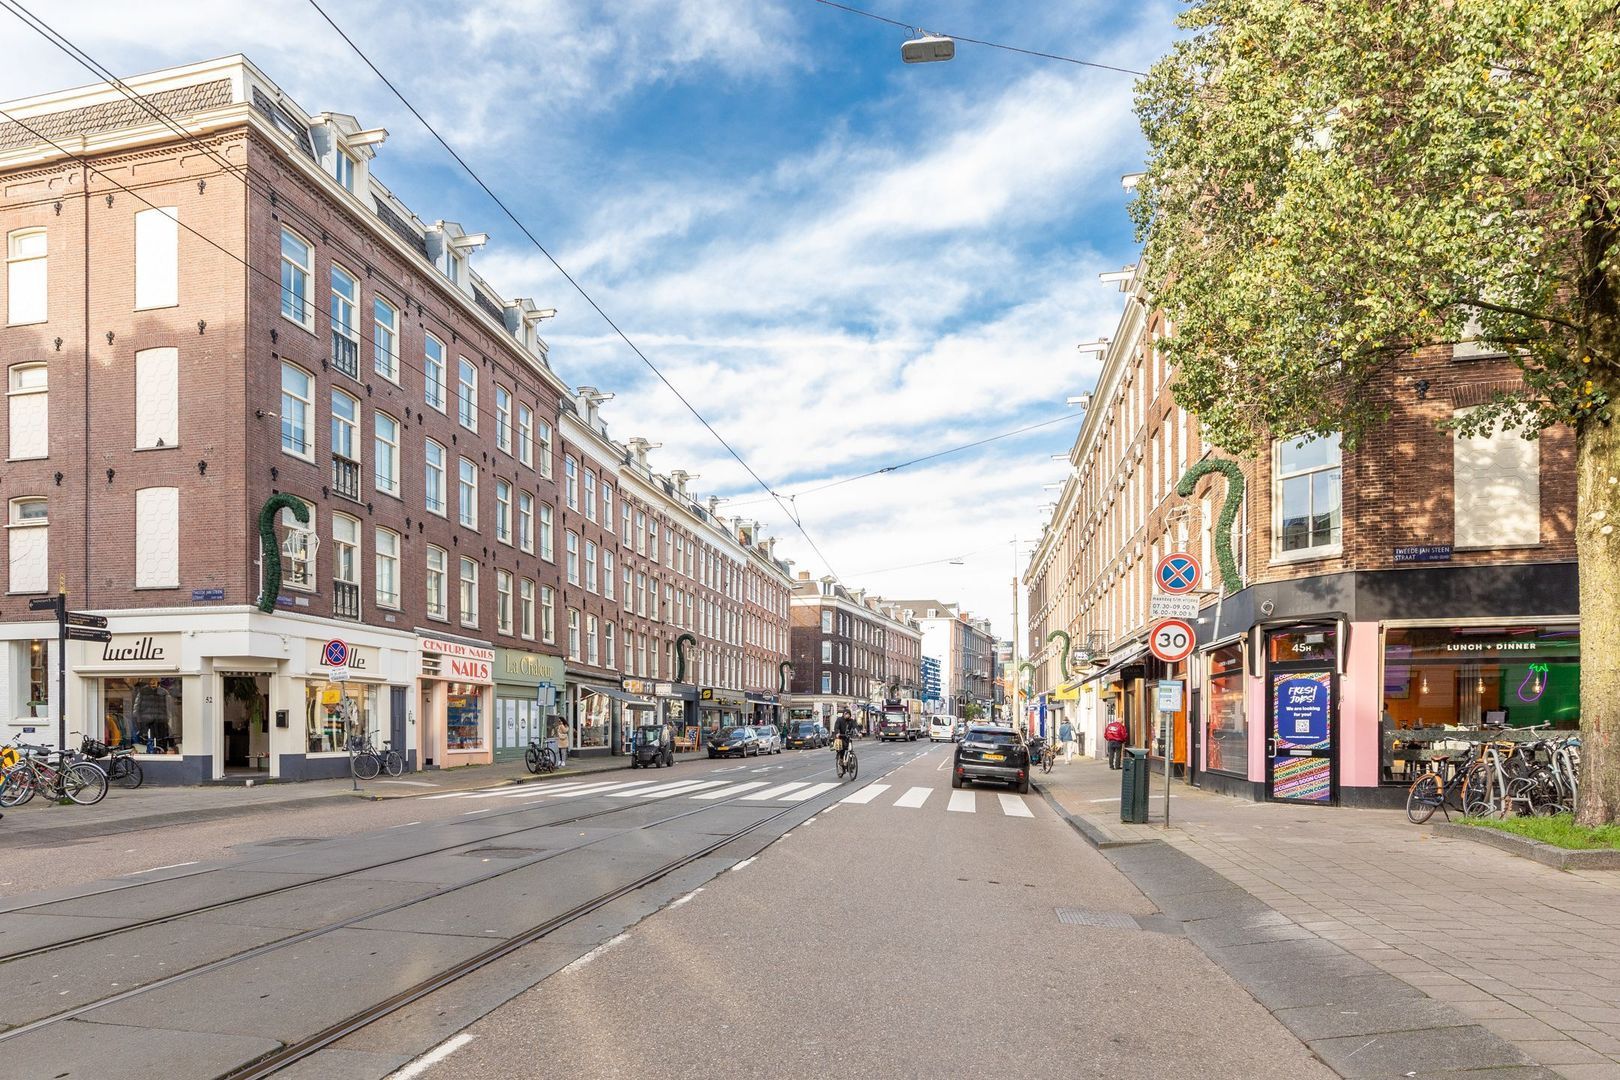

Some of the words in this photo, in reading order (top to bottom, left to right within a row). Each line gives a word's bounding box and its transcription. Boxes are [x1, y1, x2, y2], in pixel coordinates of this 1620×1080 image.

[103, 637, 164, 660] lucille
[1158, 633, 1186, 648] 30
[1292, 644, 1312, 652] 45H
[424, 640, 466, 655] CENTURY
[470, 649, 493, 660] NAILS
[452, 660, 488, 678] NAILS
[506, 654, 518, 673] La
